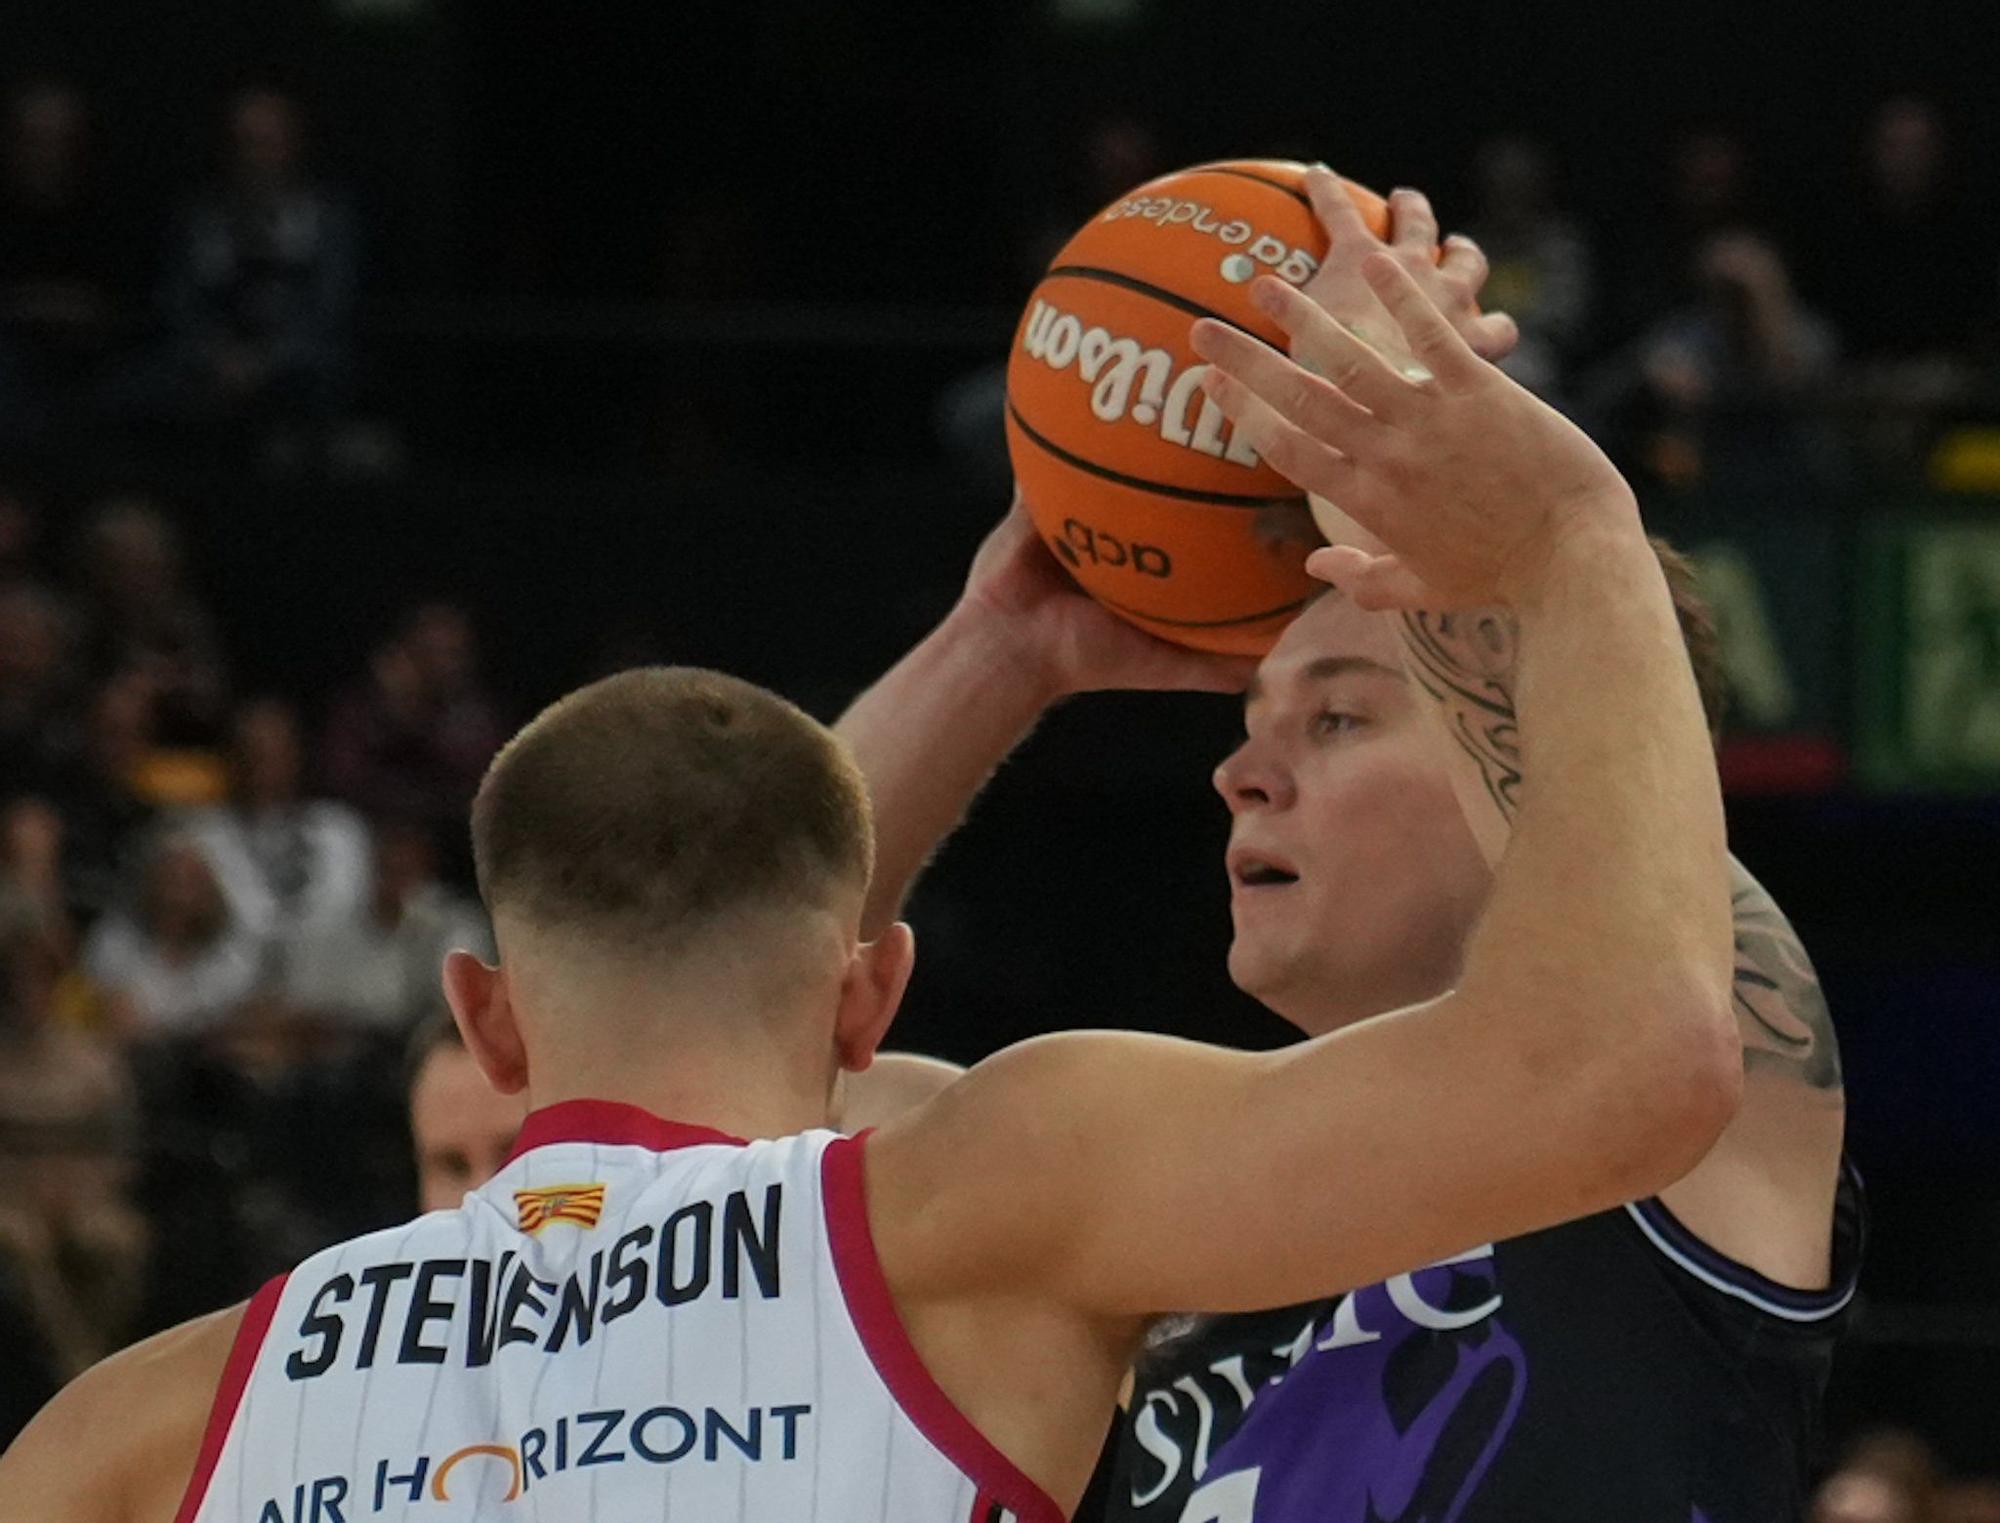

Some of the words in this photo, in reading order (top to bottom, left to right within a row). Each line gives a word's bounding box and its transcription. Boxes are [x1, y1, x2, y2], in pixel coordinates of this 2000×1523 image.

[1248, 235, 1319, 286] ga
[1063, 518, 1171, 578] acb
[286, 1183, 782, 1380] STEVENSON
[373, 1405, 811, 1512] HORIZONT
